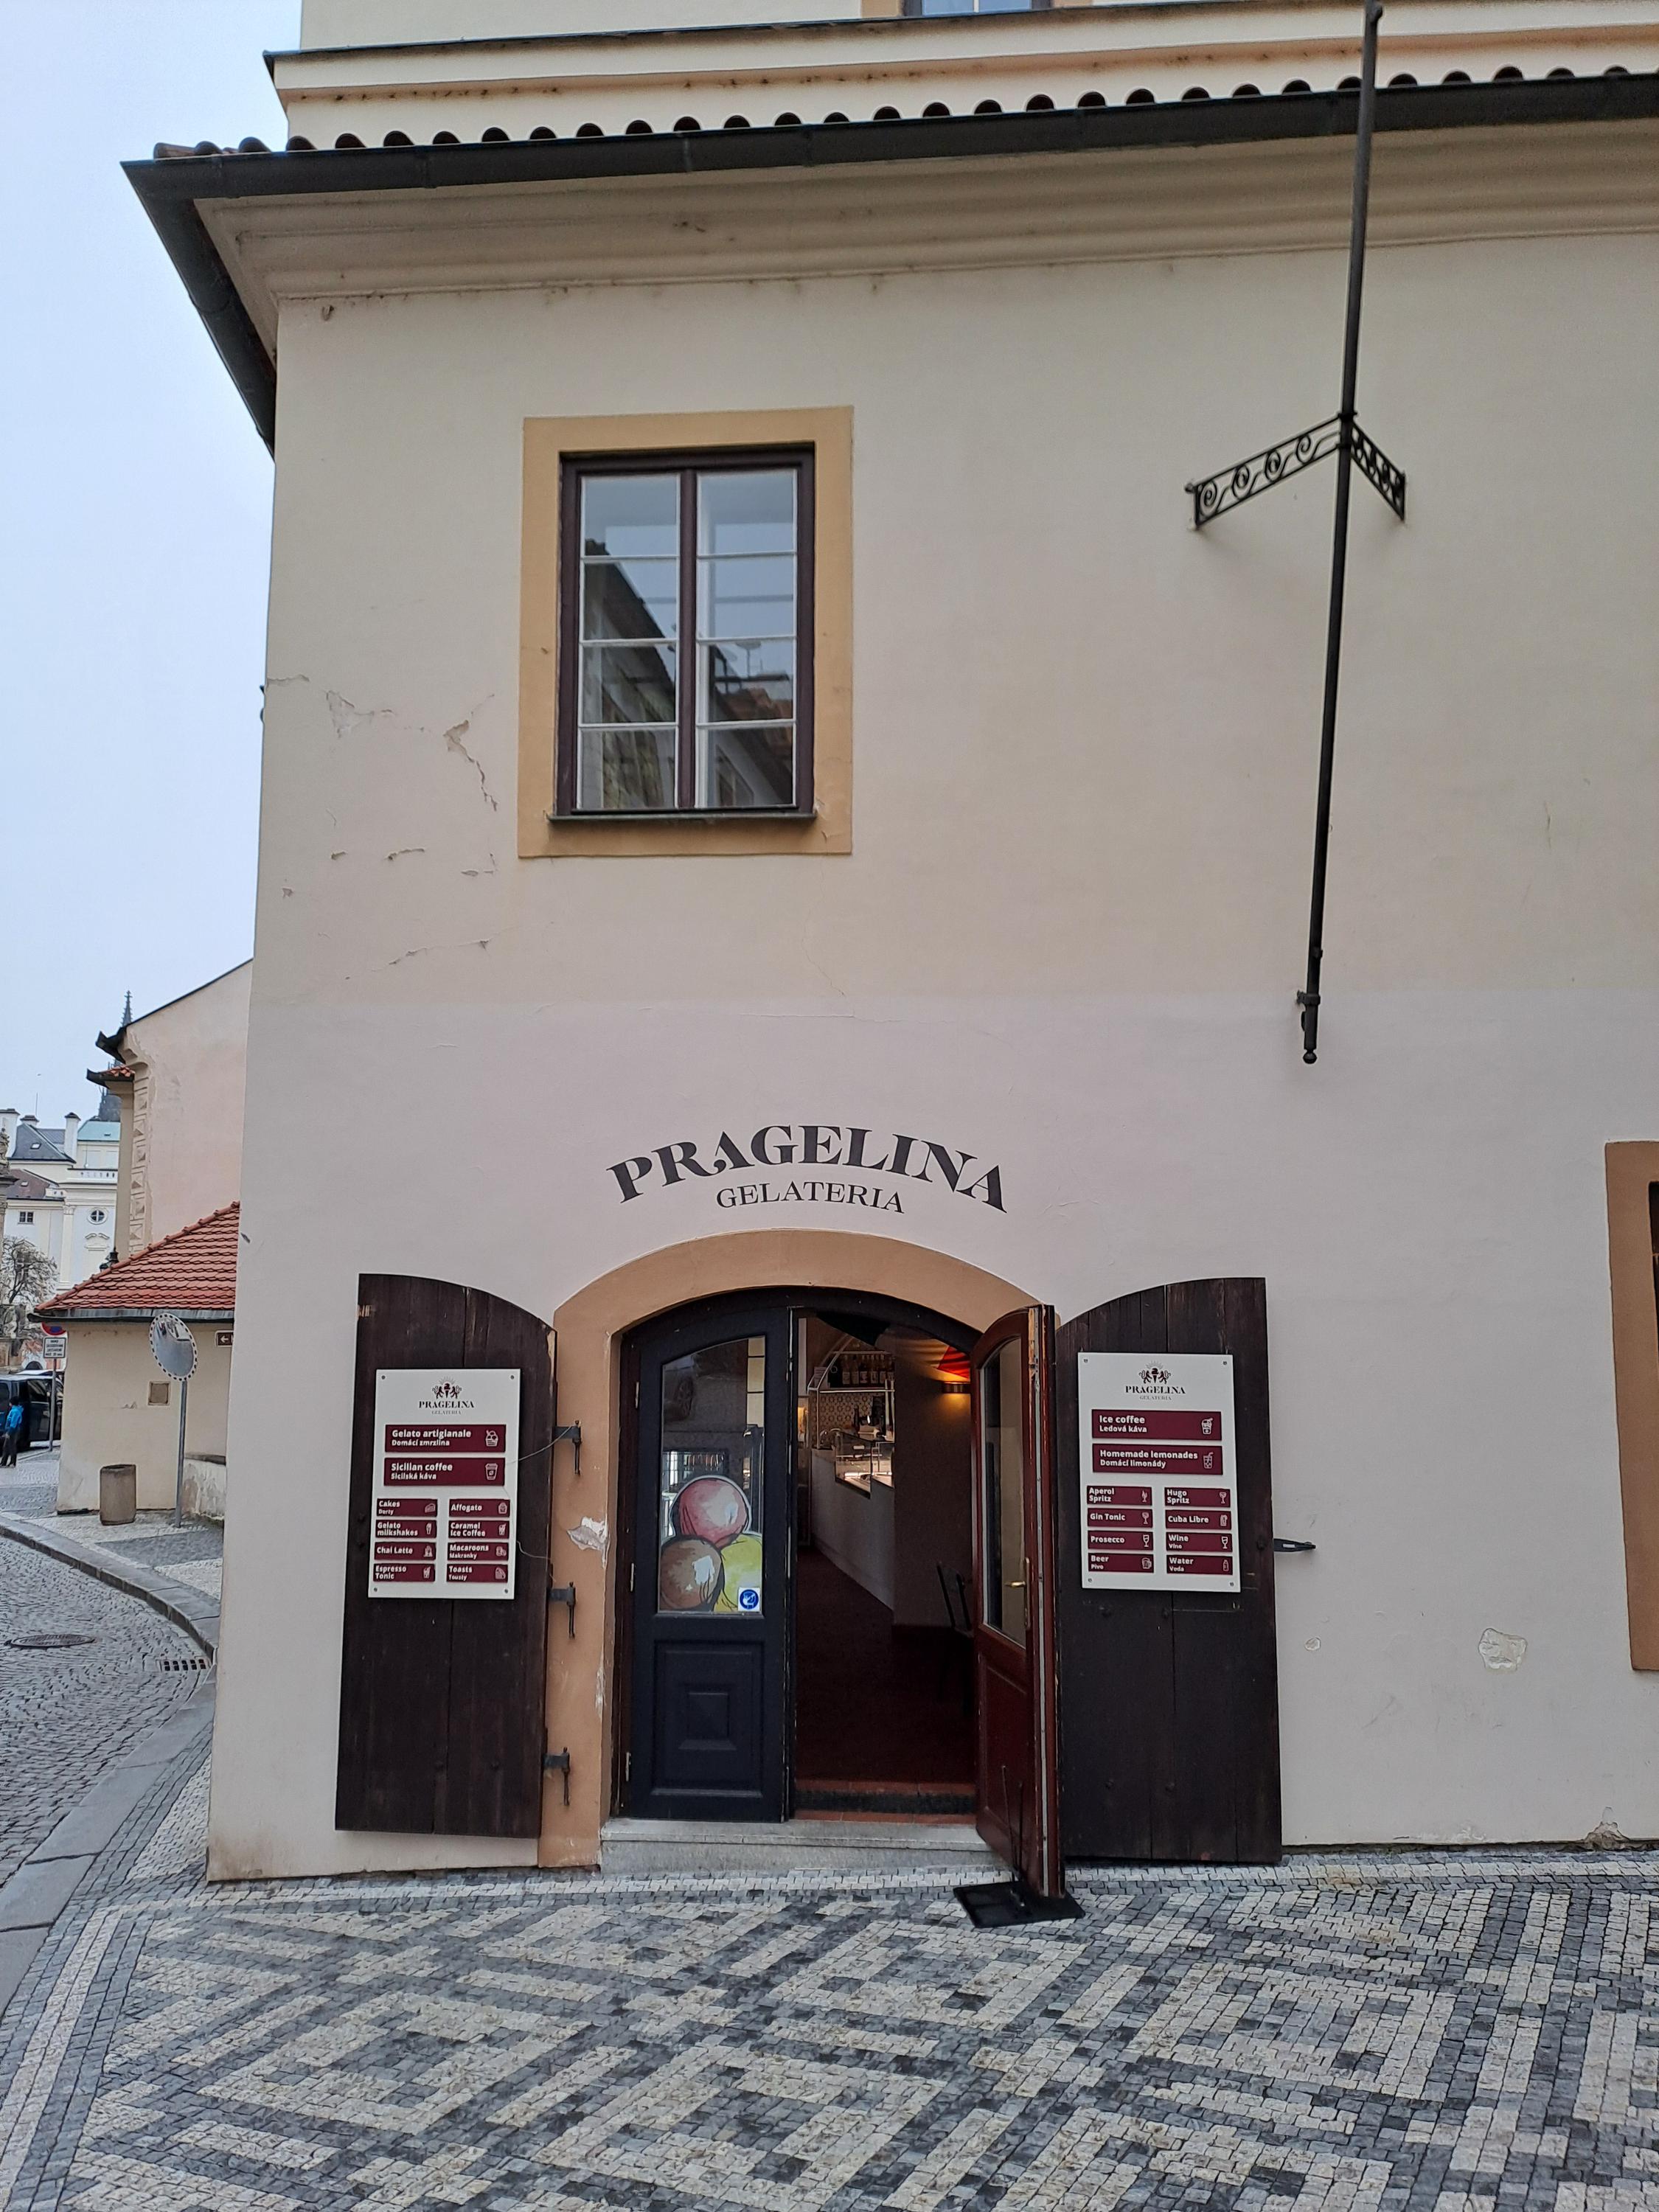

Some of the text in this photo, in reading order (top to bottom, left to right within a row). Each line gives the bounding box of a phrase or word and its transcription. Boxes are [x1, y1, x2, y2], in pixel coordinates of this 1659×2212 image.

[606, 1124, 1008, 1214] PRAGELINA
[717, 1180, 905, 1214] GELATERIA
[1125, 1385, 1186, 1394] PRAGELINA
[419, 1400, 474, 1408] PRAGELINA
[1099, 1415, 1145, 1424] Ice coffee
[392, 1430, 472, 1440] Gelato artigianale
[1100, 1450, 1198, 1459] Homemade lemonades
[391, 1463, 453, 1472] Sicilian coffee
[1130, 1459, 1166, 1469] limonády
[419, 1472, 437, 1480] káva
[1089, 1487, 1115, 1495] Aperol
[1167, 1489, 1187, 1498] Hugo
[1089, 1495, 1112, 1503] Spritz
[1167, 1497, 1190, 1505] Spritz
[451, 1503, 482, 1512] Affogato
[1169, 1557, 1194, 1565] Water
[375, 1565, 406, 1573] Espresso
